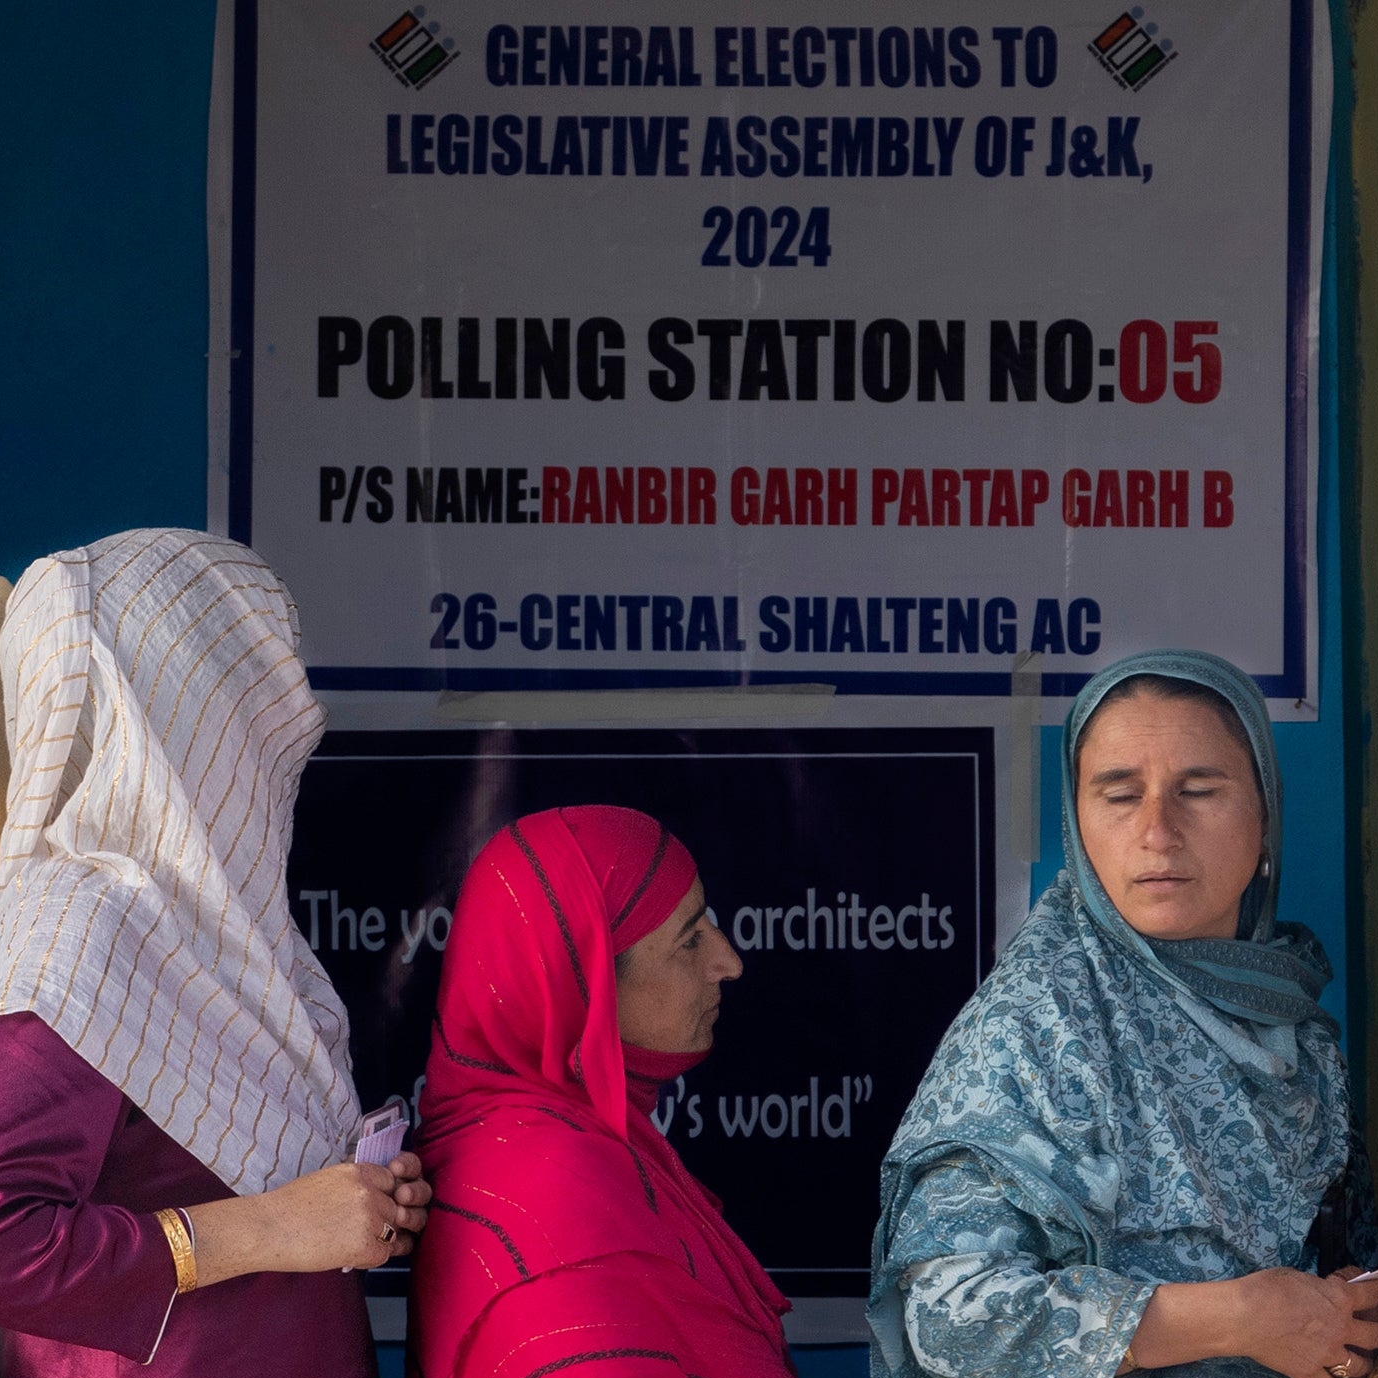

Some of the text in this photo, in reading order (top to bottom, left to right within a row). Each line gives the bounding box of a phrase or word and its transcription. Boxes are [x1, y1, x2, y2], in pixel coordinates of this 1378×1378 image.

[486, 25, 701, 86] GENERAL
[715, 27, 980, 88] ELECTIONS
[993, 26, 1057, 88] TO
[387, 114, 1152, 183] LEGISLATIVE ASSEMBLY OF J&K,
[702, 206, 831, 267] 2024
[318, 316, 625, 401] POLLING
[648, 317, 965, 403] STATION
[320, 466, 393, 523] P/S
[731, 467, 857, 525] GARH
[872, 469, 1049, 526] PARTAP
[1062, 469, 1188, 527] GARH
[1204, 471, 1233, 527] B
[430, 593, 1100, 655] 26-CENTRAL SHALTENG AC
[299, 889, 385, 950] The
[733, 888, 954, 950] architects
